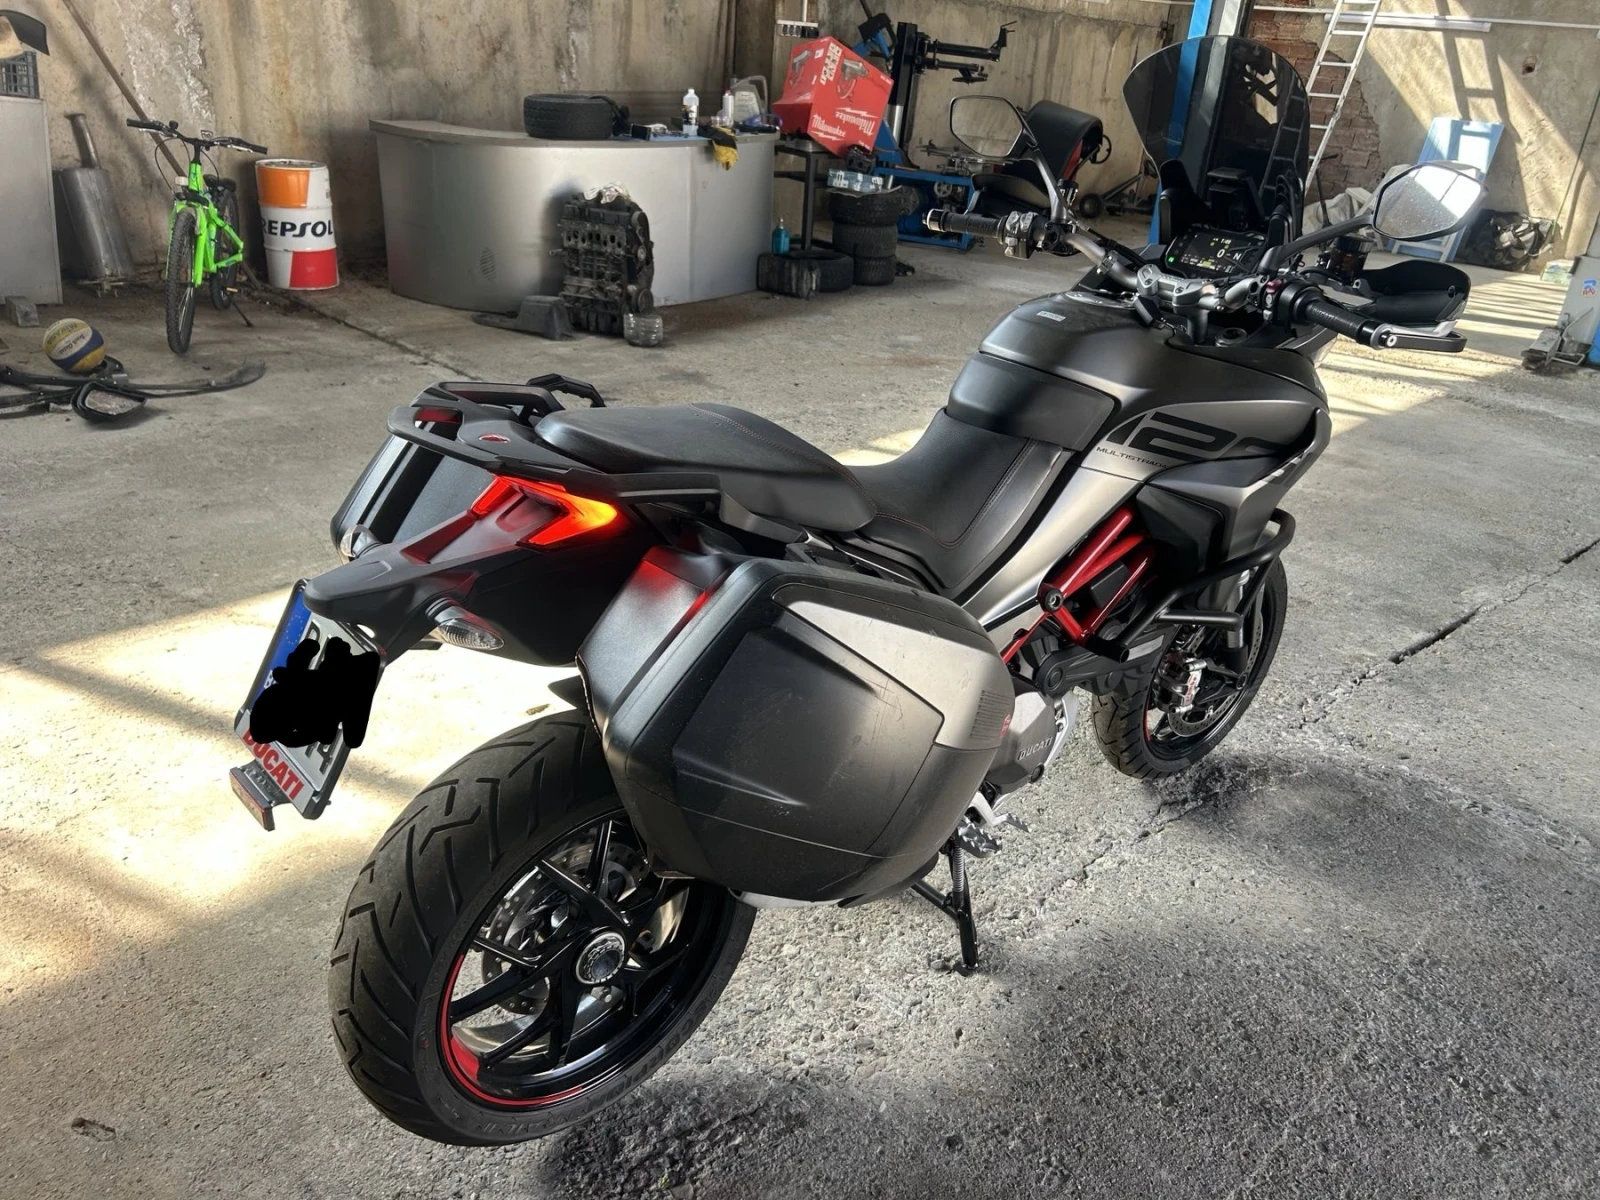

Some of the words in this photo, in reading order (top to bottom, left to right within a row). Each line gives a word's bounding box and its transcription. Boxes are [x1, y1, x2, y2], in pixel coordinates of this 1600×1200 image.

[812, 114, 847, 138] Milwaukee
[835, 112, 874, 136] Milwaukee
[1096, 446, 1168, 469] MULTISTRADA
[1017, 736, 1053, 760] DUCATI
